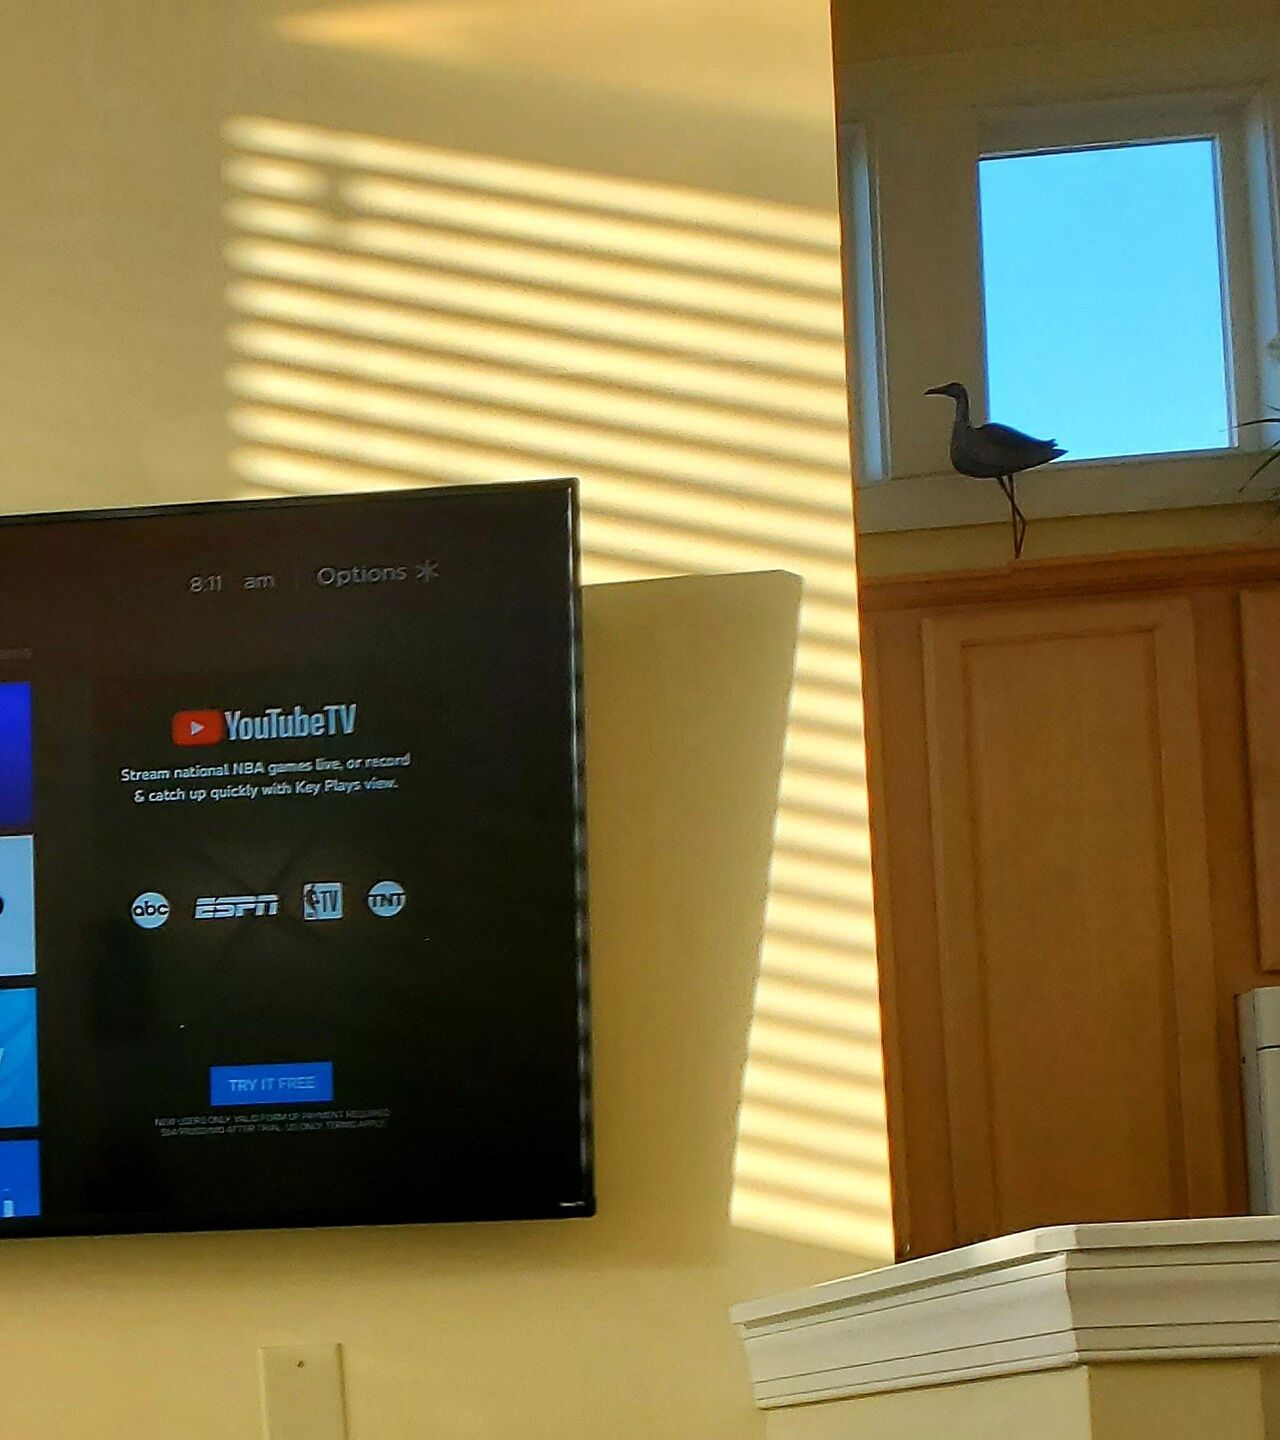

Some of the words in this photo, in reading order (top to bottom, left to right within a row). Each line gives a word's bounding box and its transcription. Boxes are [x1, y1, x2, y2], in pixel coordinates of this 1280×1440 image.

[243, 573, 275, 589] am
[317, 563, 407, 587] Options
[121, 768, 170, 782] Stream
[174, 764, 229, 779] national
[232, 762, 265, 775] NBA
[267, 761, 313, 776] games
[346, 759, 362, 769] or
[365, 753, 410, 768] record
[149, 788, 185, 801] catch
[190, 789, 206, 802] up
[210, 785, 258, 800] quickly
[261, 783, 291, 795] with
[295, 781, 320, 797] Key
[324, 779, 360, 793] Plays
[133, 900, 169, 917] abc
[194, 894, 280, 920] ESPN
[368, 892, 406, 908] TNT
[228, 1077, 257, 1091] TRY
[261, 1077, 274, 1090] IT
[278, 1076, 316, 1090] FREE
